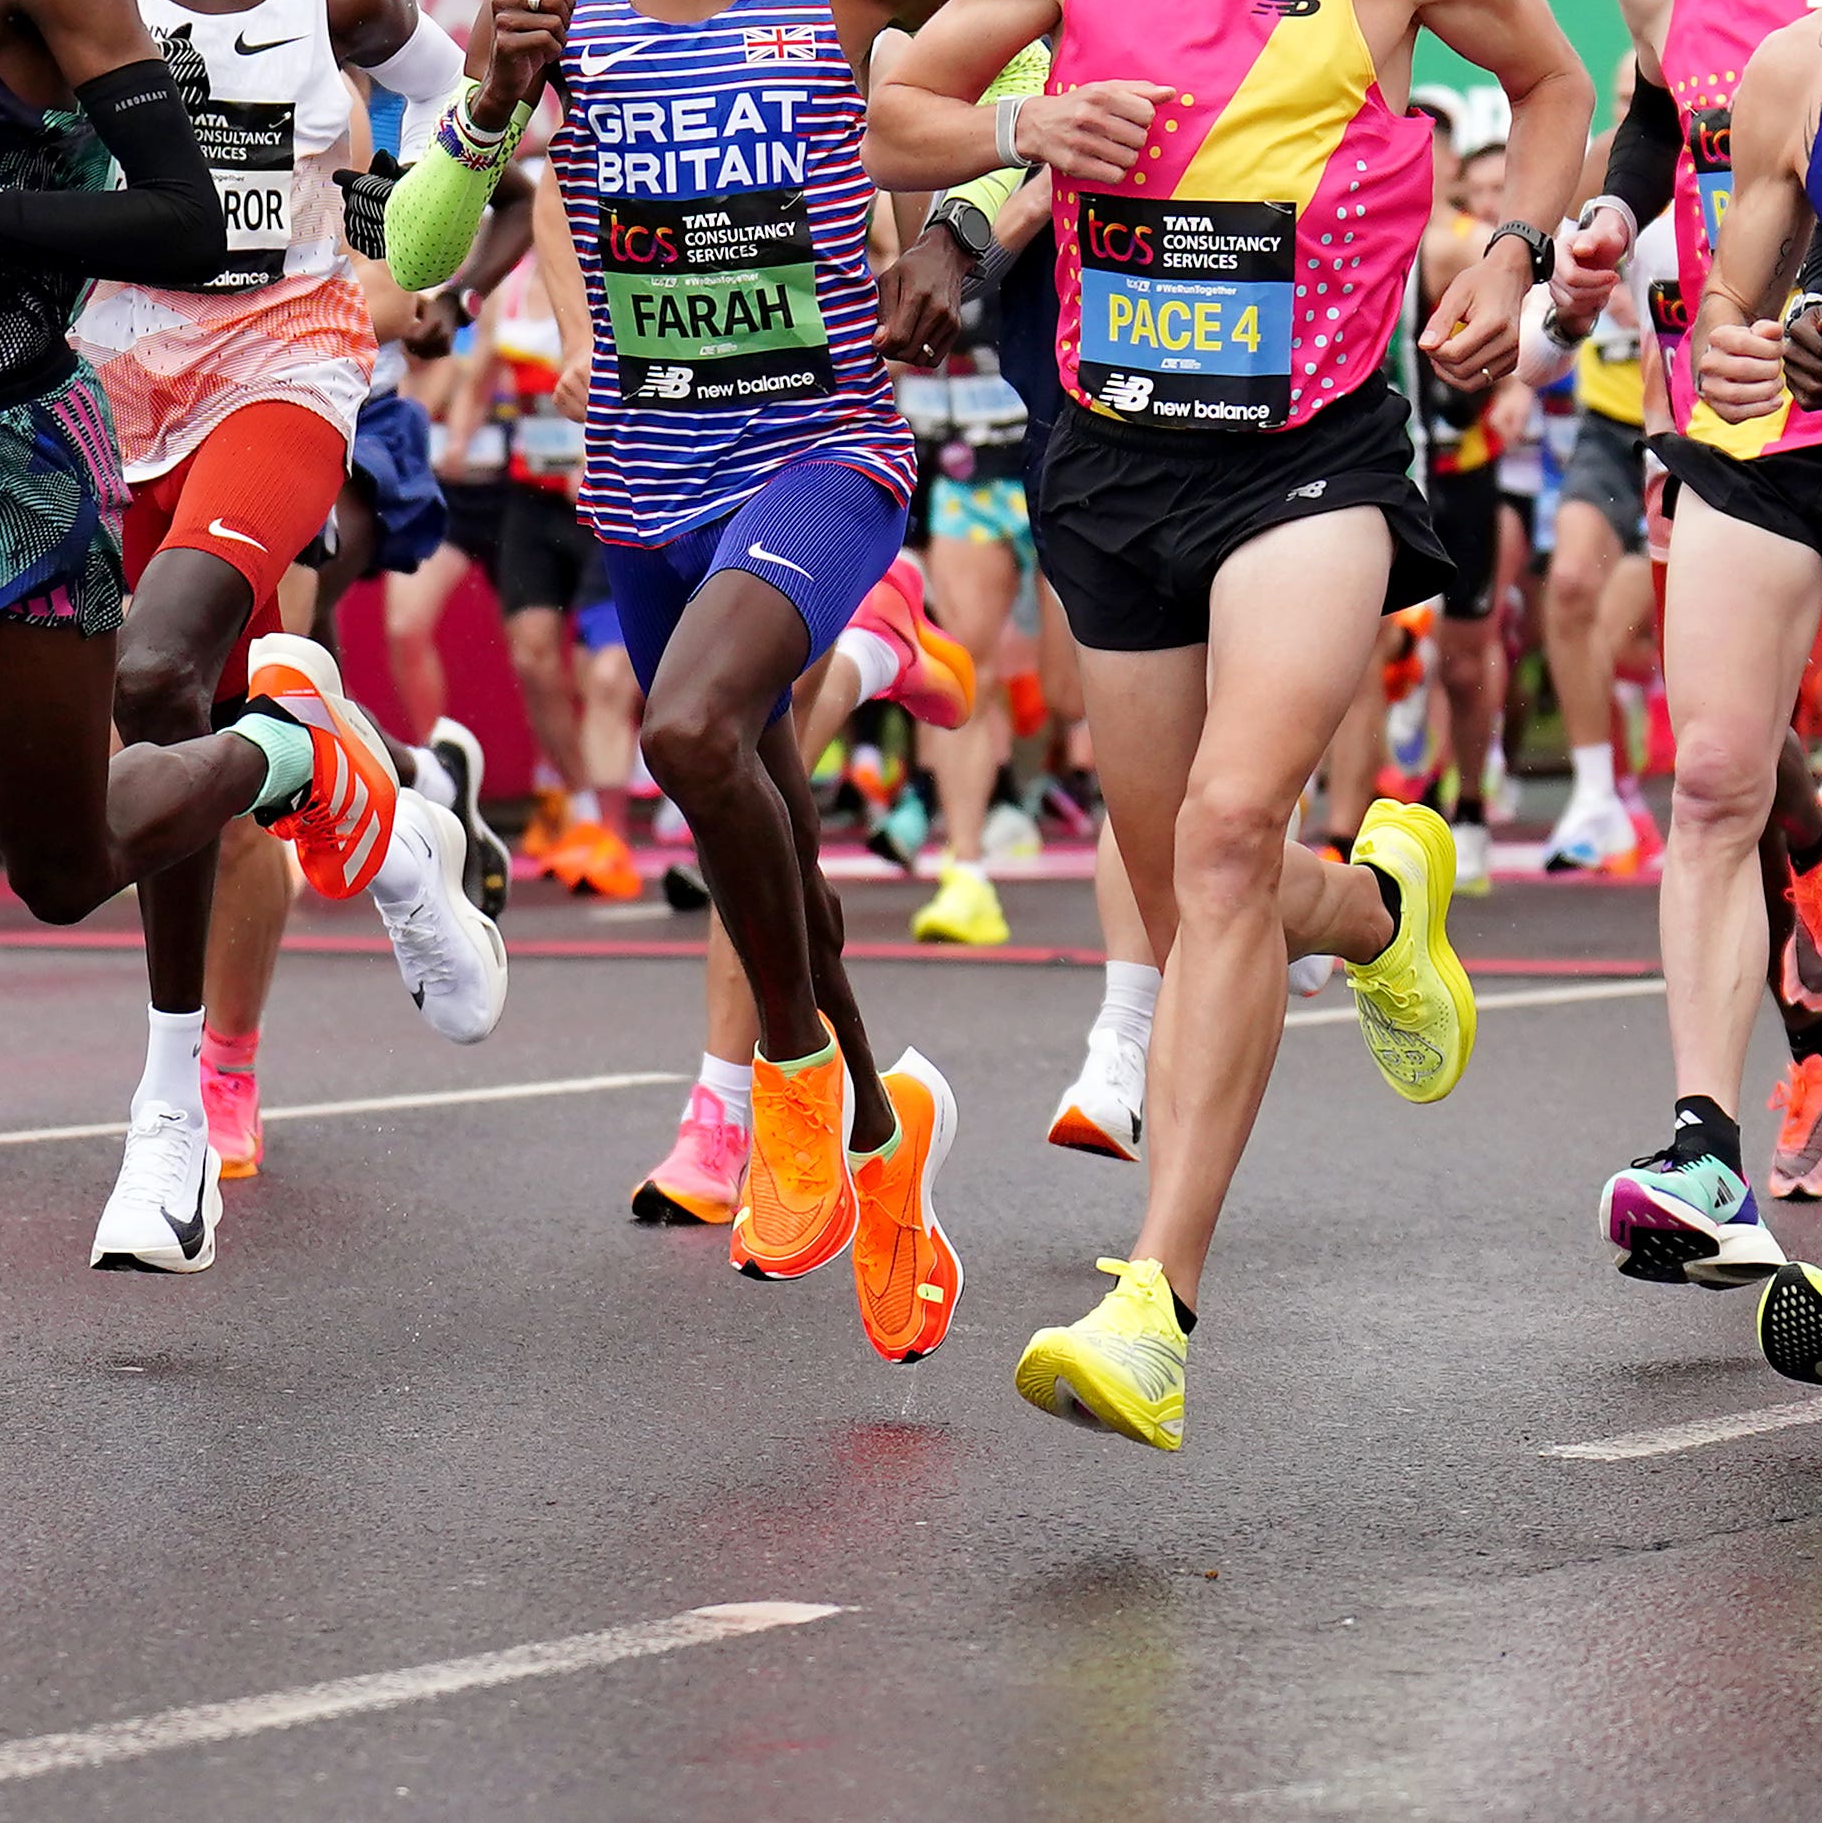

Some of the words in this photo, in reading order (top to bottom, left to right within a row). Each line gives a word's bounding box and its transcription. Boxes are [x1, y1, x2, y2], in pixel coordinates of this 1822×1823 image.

[189, 113, 228, 128] ATA
[587, 90, 809, 145] GREAT
[194, 129, 282, 146] ONSULTANCY
[200, 145, 248, 161] RVICES
[597, 141, 808, 195] BRITAIN
[611, 212, 679, 264] tcs
[682, 211, 730, 229] TATA
[684, 221, 796, 247] CONSULTANCY
[1088, 209, 1154, 265] tcs
[1163, 216, 1214, 233] TATA
[1163, 234, 1281, 254] CONSULTANCY
[687, 243, 758, 264] SERVICES
[1163, 252, 1238, 270] SERVICES
[632, 283, 795, 339] FARAH
[1108, 292, 1222, 352] PACE
[1231, 305, 1261, 353] 4
[697, 383, 735, 400] new
[738, 371, 815, 395] balance
[1153, 401, 1190, 419] new
[1193, 398, 1270, 422] balance
